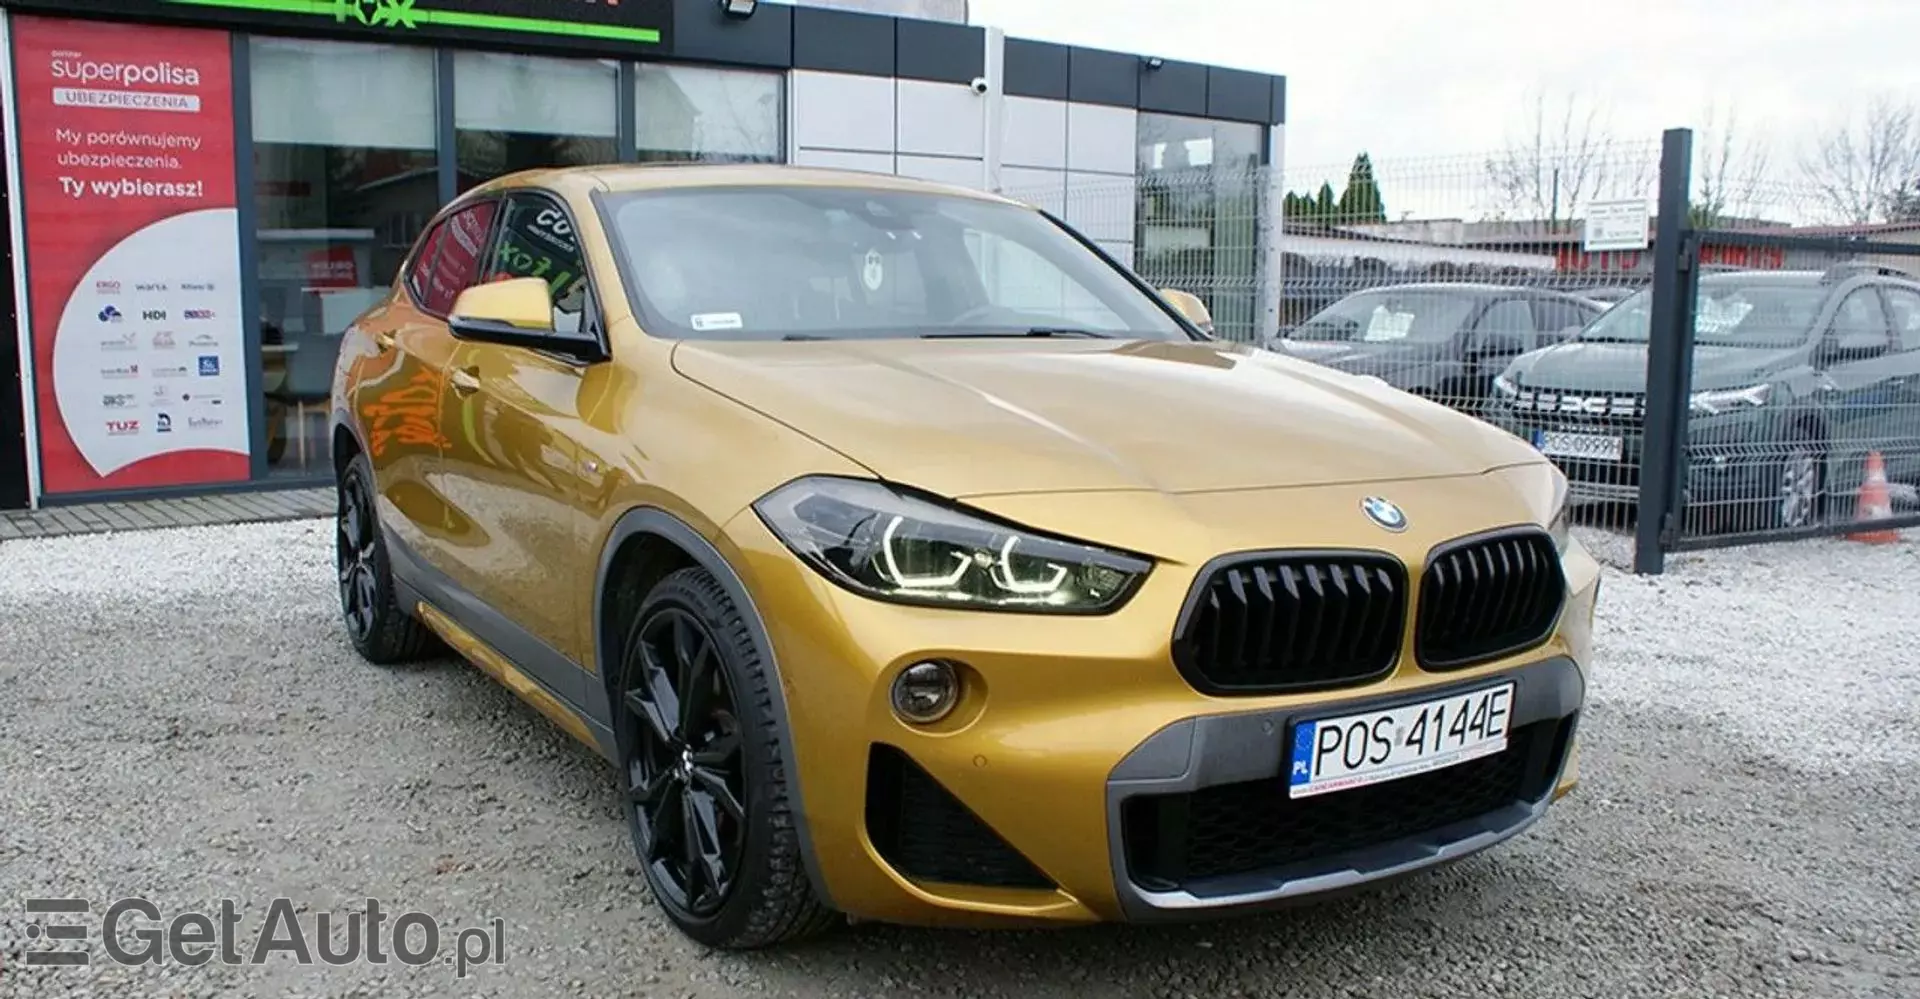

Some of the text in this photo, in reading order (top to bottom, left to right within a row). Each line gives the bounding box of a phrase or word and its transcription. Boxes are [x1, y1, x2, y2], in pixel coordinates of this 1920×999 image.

[51, 59, 200, 87] superpolisa
[65, 90, 189, 109] UBEZPIECZENIA
[56, 129, 201, 150] My porównujemy
[57, 152, 182, 170] ubezpieczenia.
[59, 176, 204, 198] Ty wybierasz!
[143, 310, 166, 320] HDI
[105, 420, 139, 431] TUZ
[1315, 690, 1508, 776] POS 4144E
